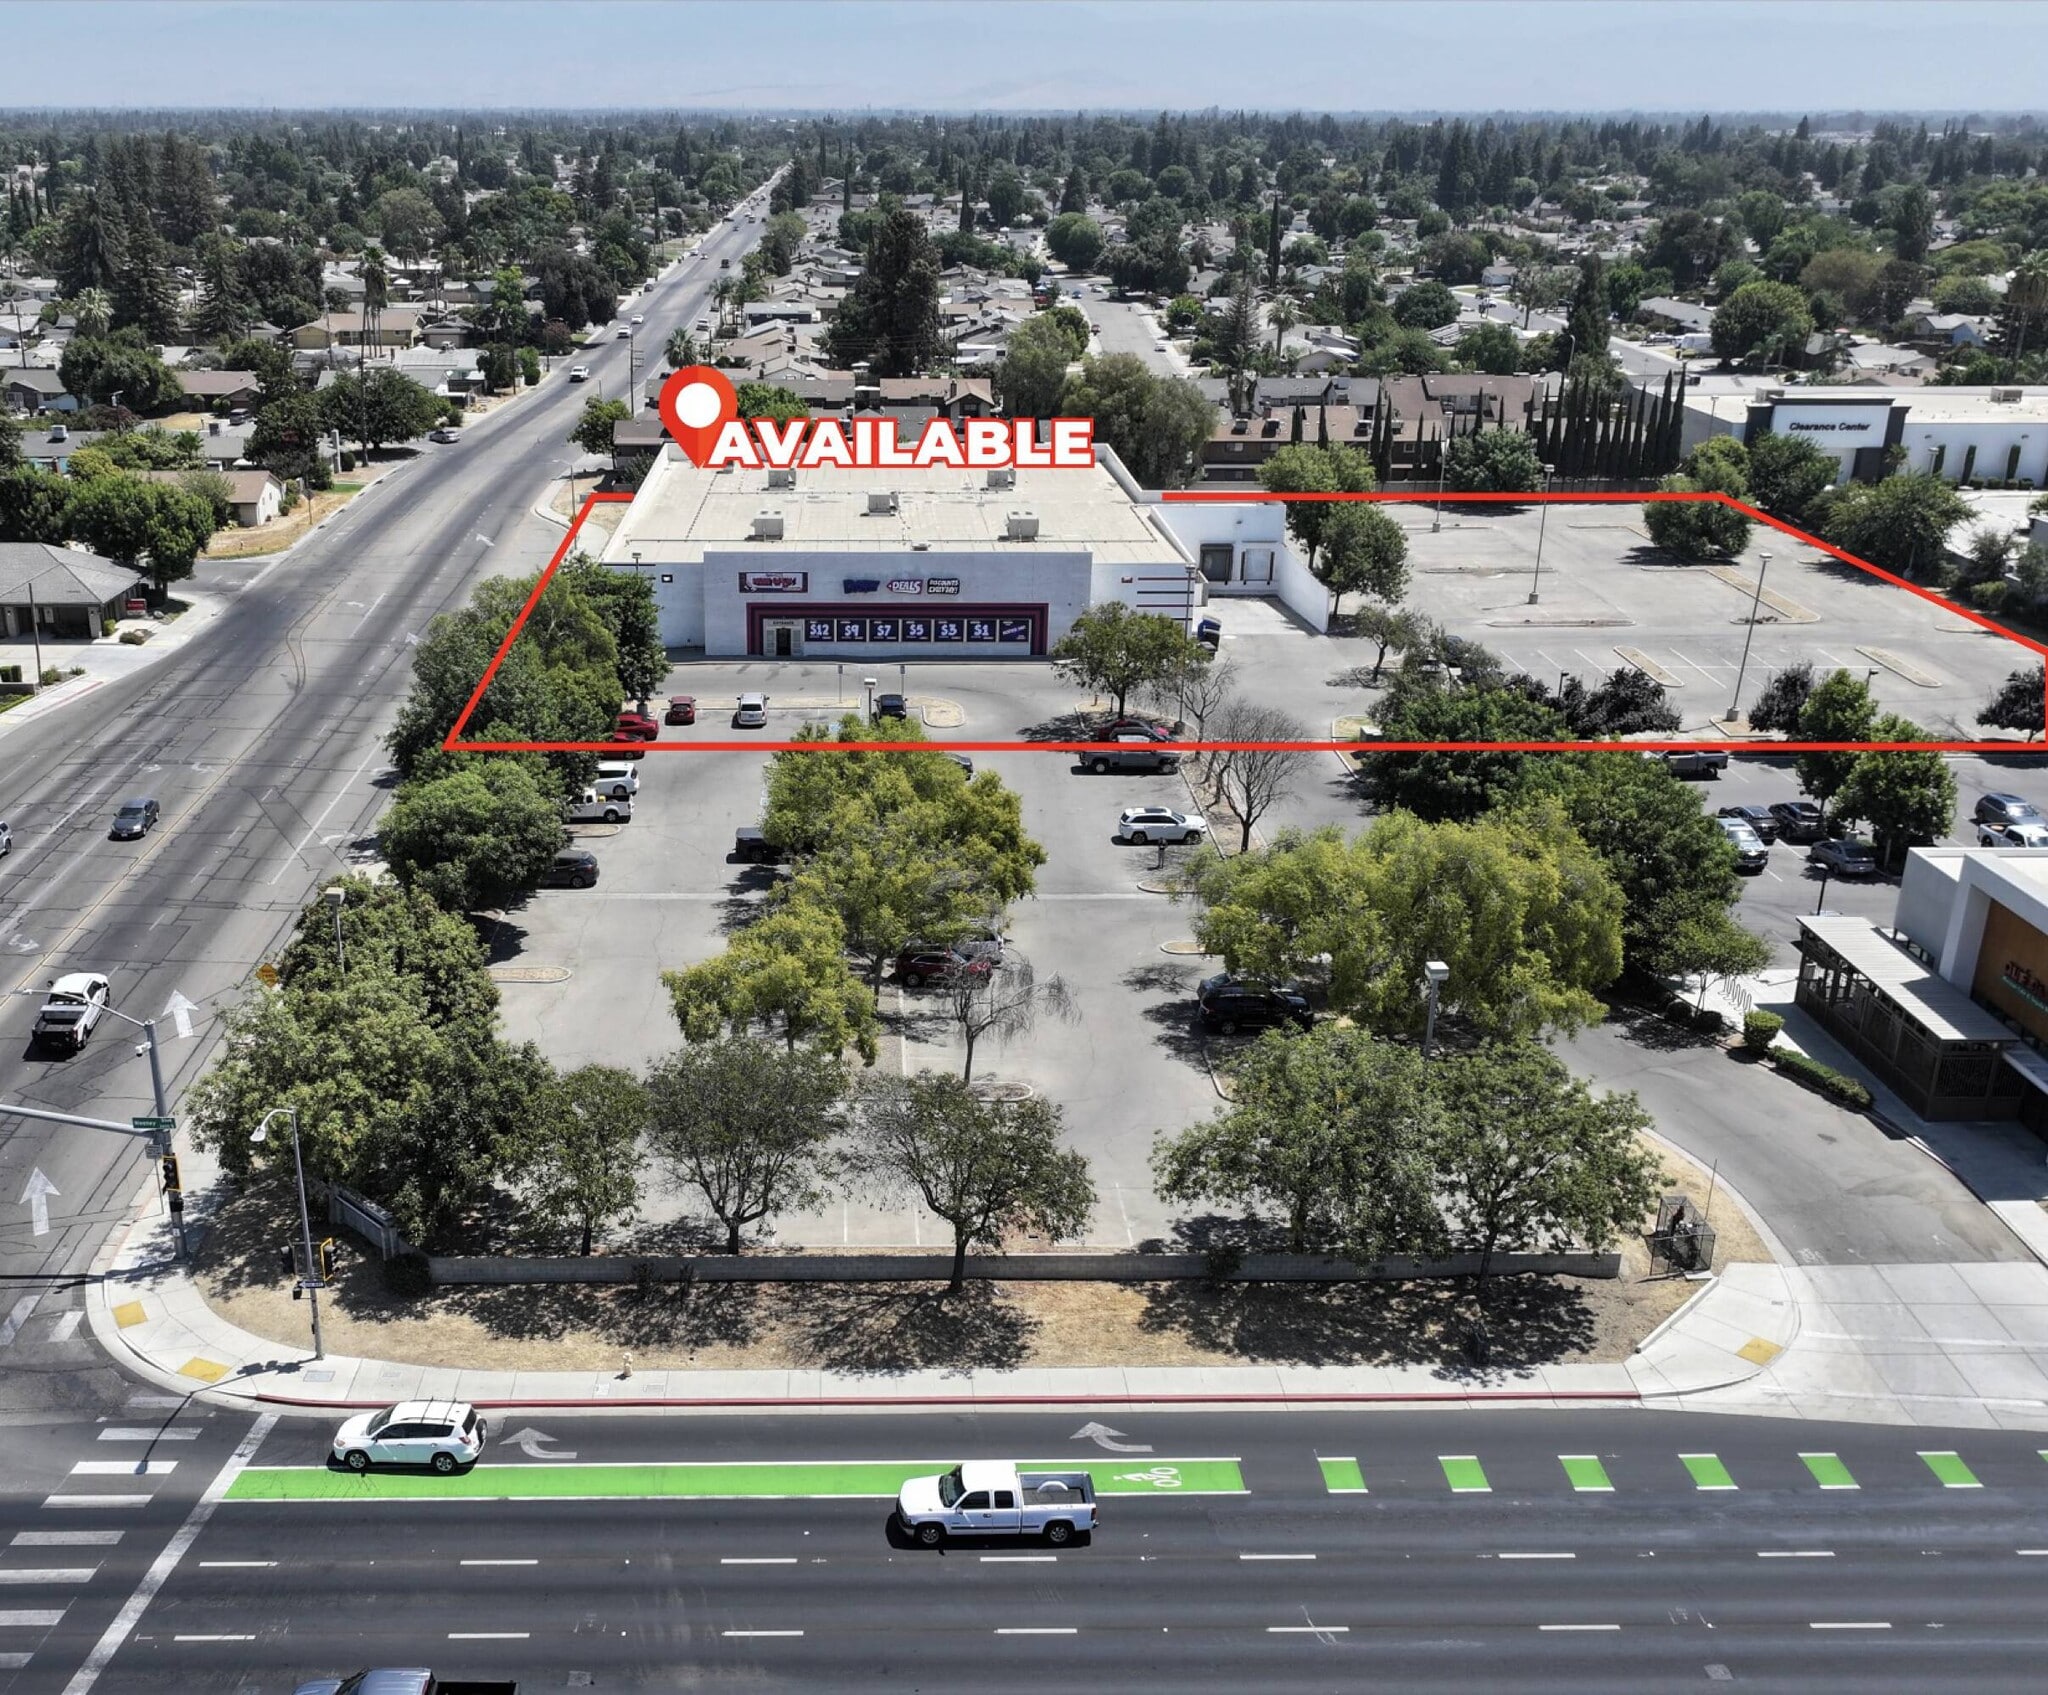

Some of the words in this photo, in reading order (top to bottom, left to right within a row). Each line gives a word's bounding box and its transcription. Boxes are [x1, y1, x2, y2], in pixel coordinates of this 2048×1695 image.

[1789, 422, 1836, 431] Clearance
[1839, 422, 1871, 431] Center
[892, 581, 920, 592] DEALS
[810, 624, 829, 635] $12
[845, 624, 860, 636] $9
[877, 625, 892, 636] $7
[909, 624, 924, 636] $5
[941, 624, 957, 636] $3
[974, 624, 989, 636] $1
